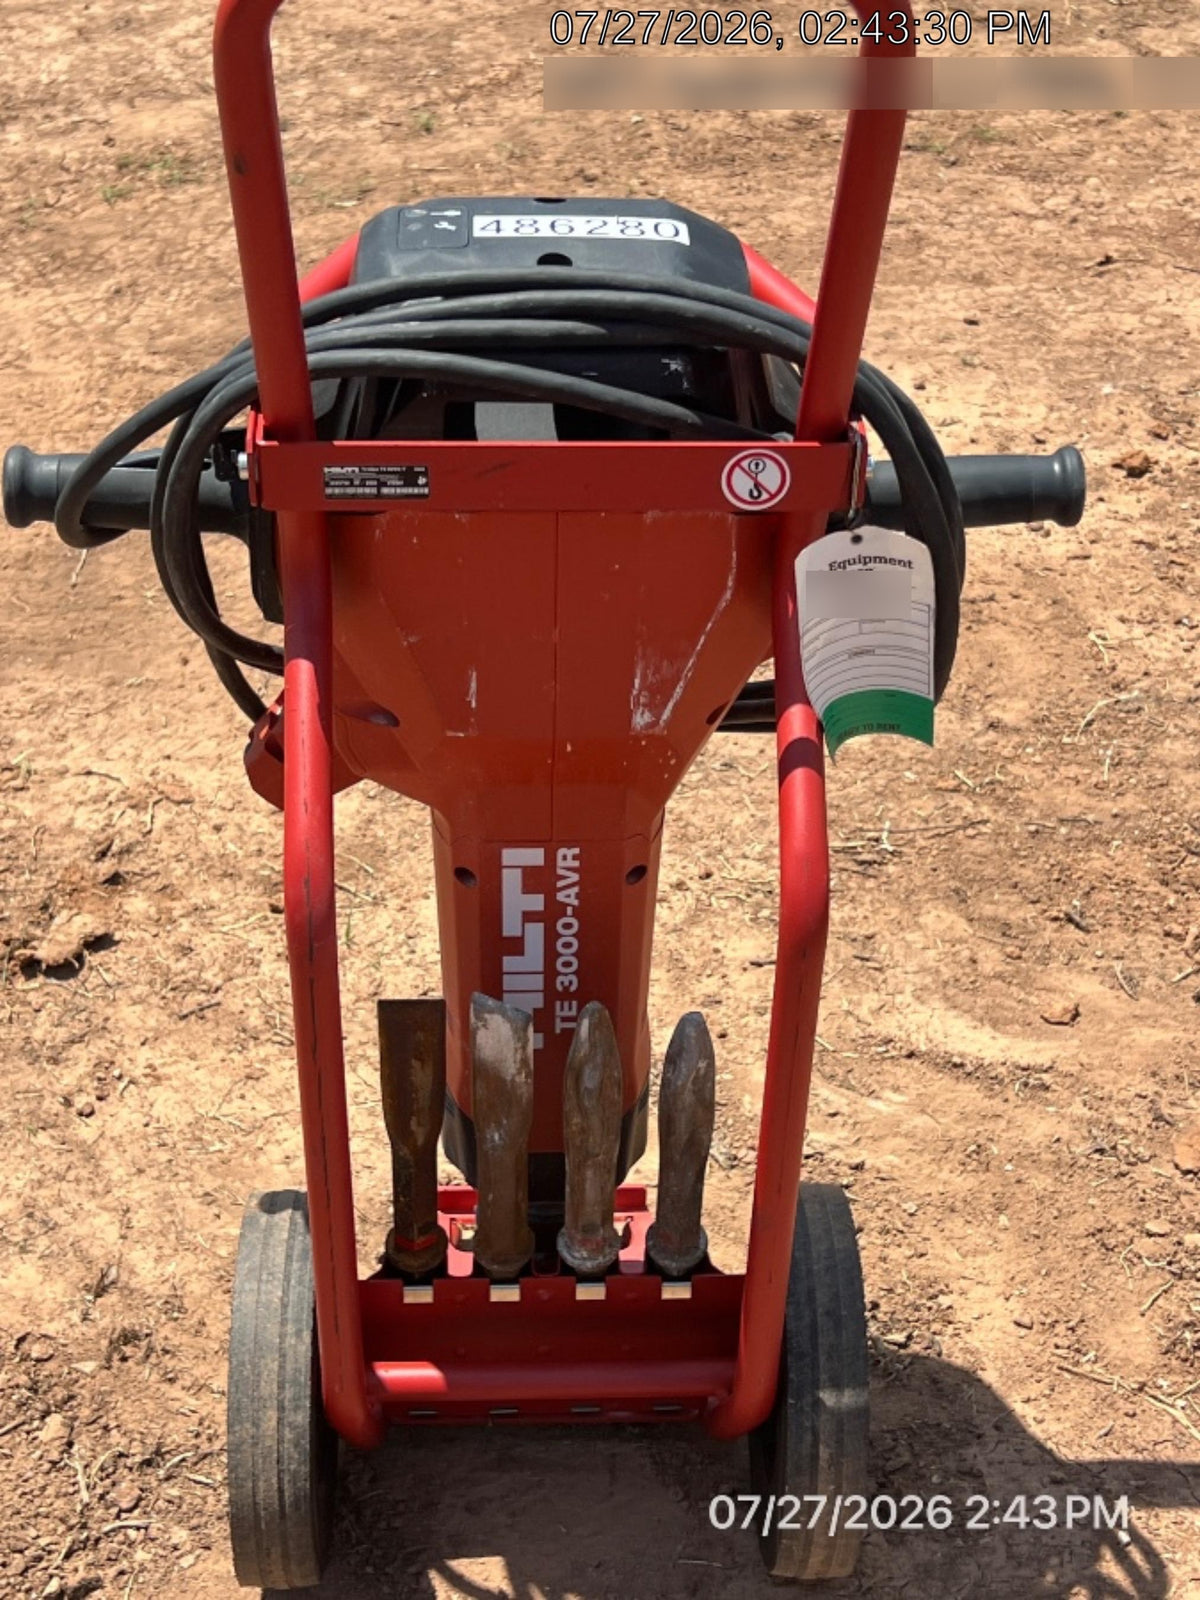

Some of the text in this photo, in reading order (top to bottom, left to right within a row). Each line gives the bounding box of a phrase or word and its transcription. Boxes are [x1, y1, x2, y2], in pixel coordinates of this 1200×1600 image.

[480, 218, 681, 239] 486280
[828, 554, 914, 571] Equipment
[555, 847, 580, 1034] TE 3000-AVR
